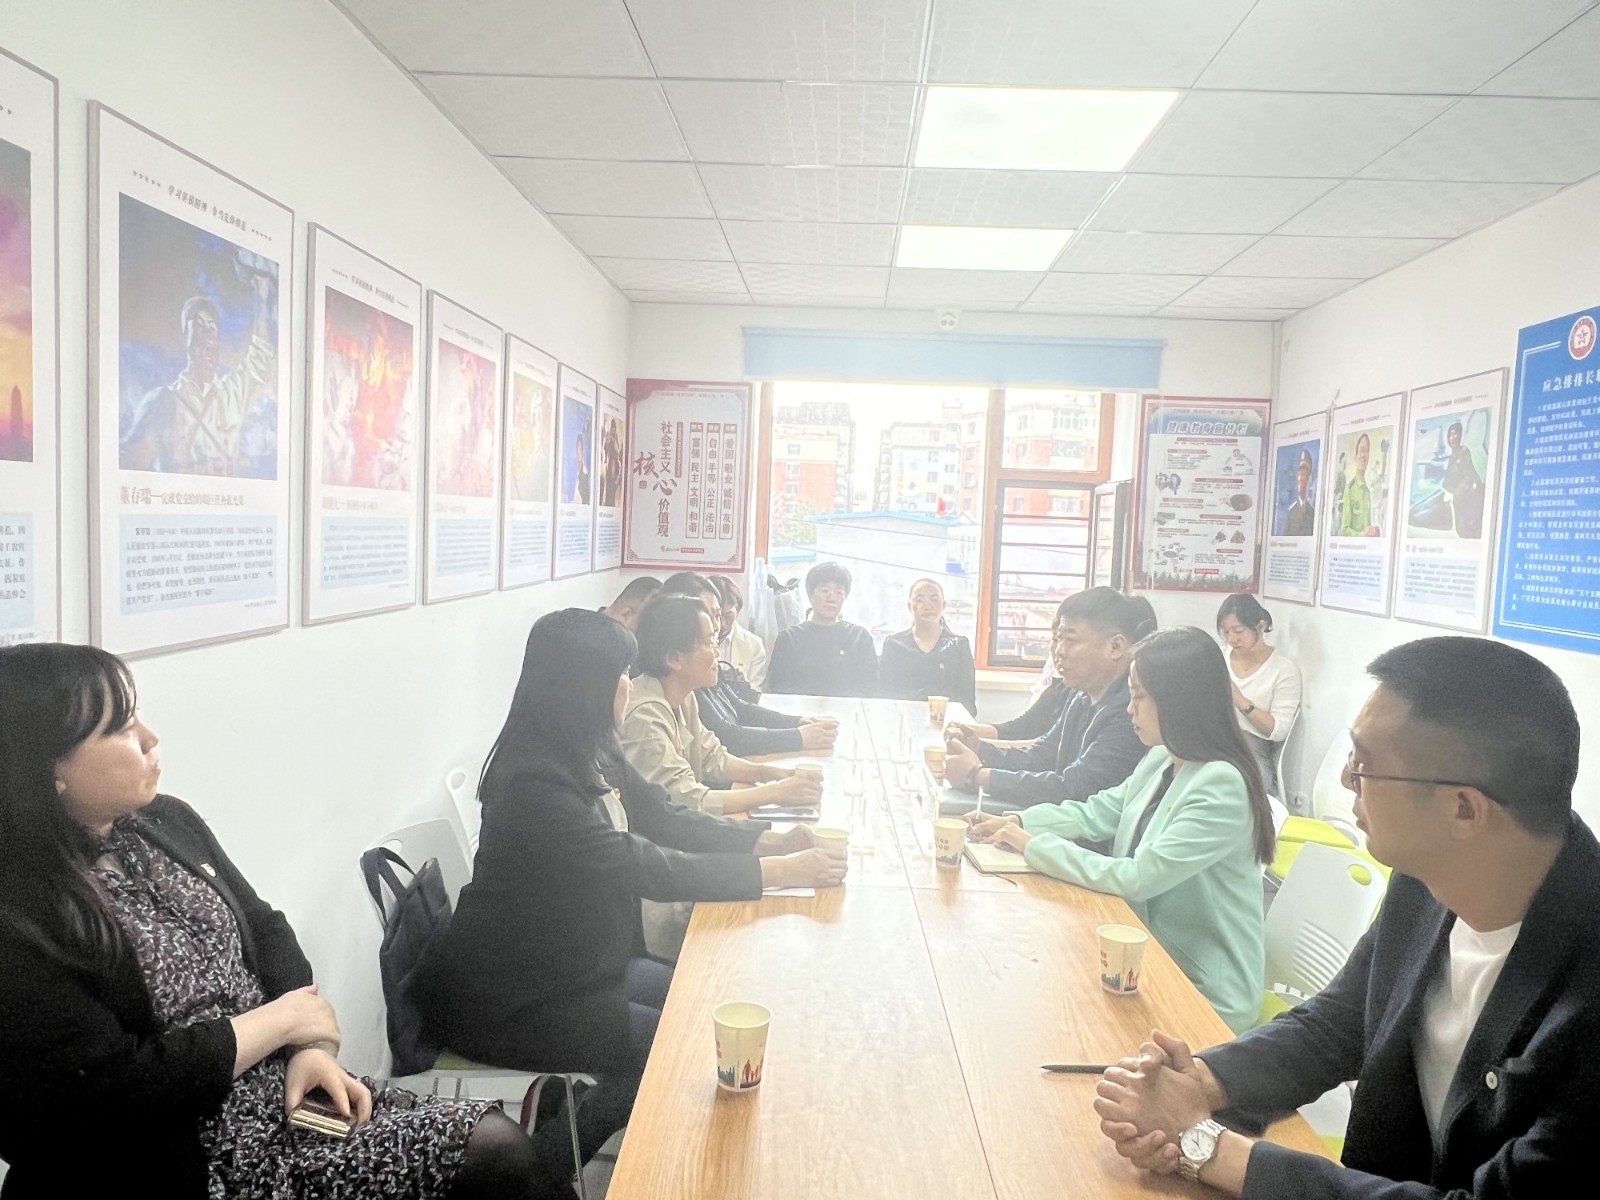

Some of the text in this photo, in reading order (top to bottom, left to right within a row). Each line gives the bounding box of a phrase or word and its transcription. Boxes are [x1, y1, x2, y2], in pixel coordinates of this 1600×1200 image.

[660, 420, 673, 474] 社会主义
[691, 437, 701, 459] 富强
[708, 438, 717, 459] 自由
[690, 462, 700, 483] 民主
[689, 487, 699, 508] 文明
[706, 487, 716, 509] 公正
[657, 498, 670, 537] 价值观
[688, 511, 698, 533] 和谐
[705, 512, 715, 533] 法治
